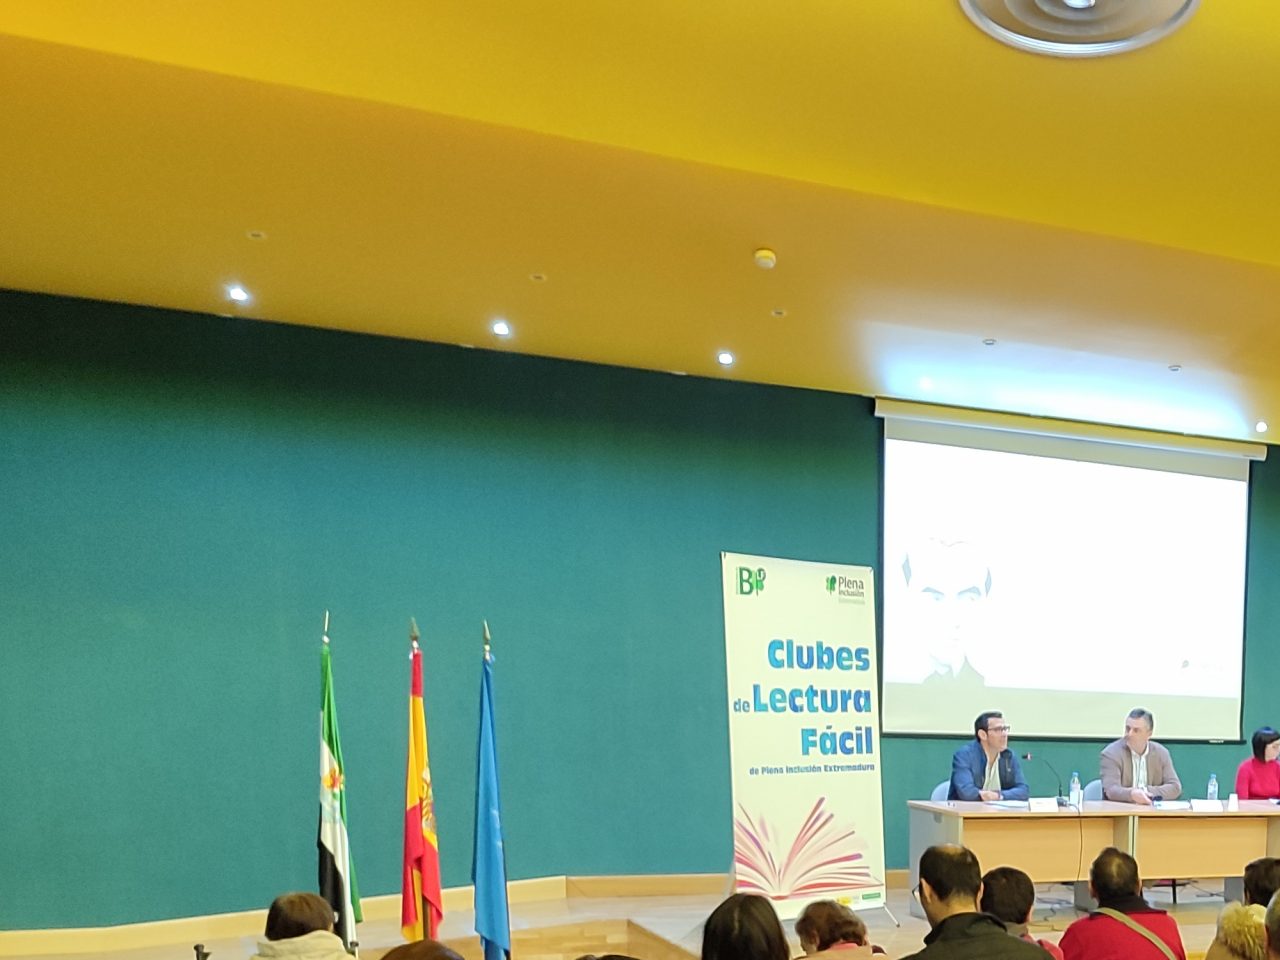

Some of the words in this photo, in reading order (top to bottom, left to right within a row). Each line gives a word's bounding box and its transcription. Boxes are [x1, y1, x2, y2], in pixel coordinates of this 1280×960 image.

[838, 575, 865, 590] Plena
[767, 639, 870, 671] Clubes
[733, 698, 751, 713] de
[752, 683, 872, 713] Lectura
[800, 725, 874, 755] Fácil
[749, 766, 760, 775] de
[761, 765, 784, 775] Plena
[823, 762, 875, 773] Extremadura
